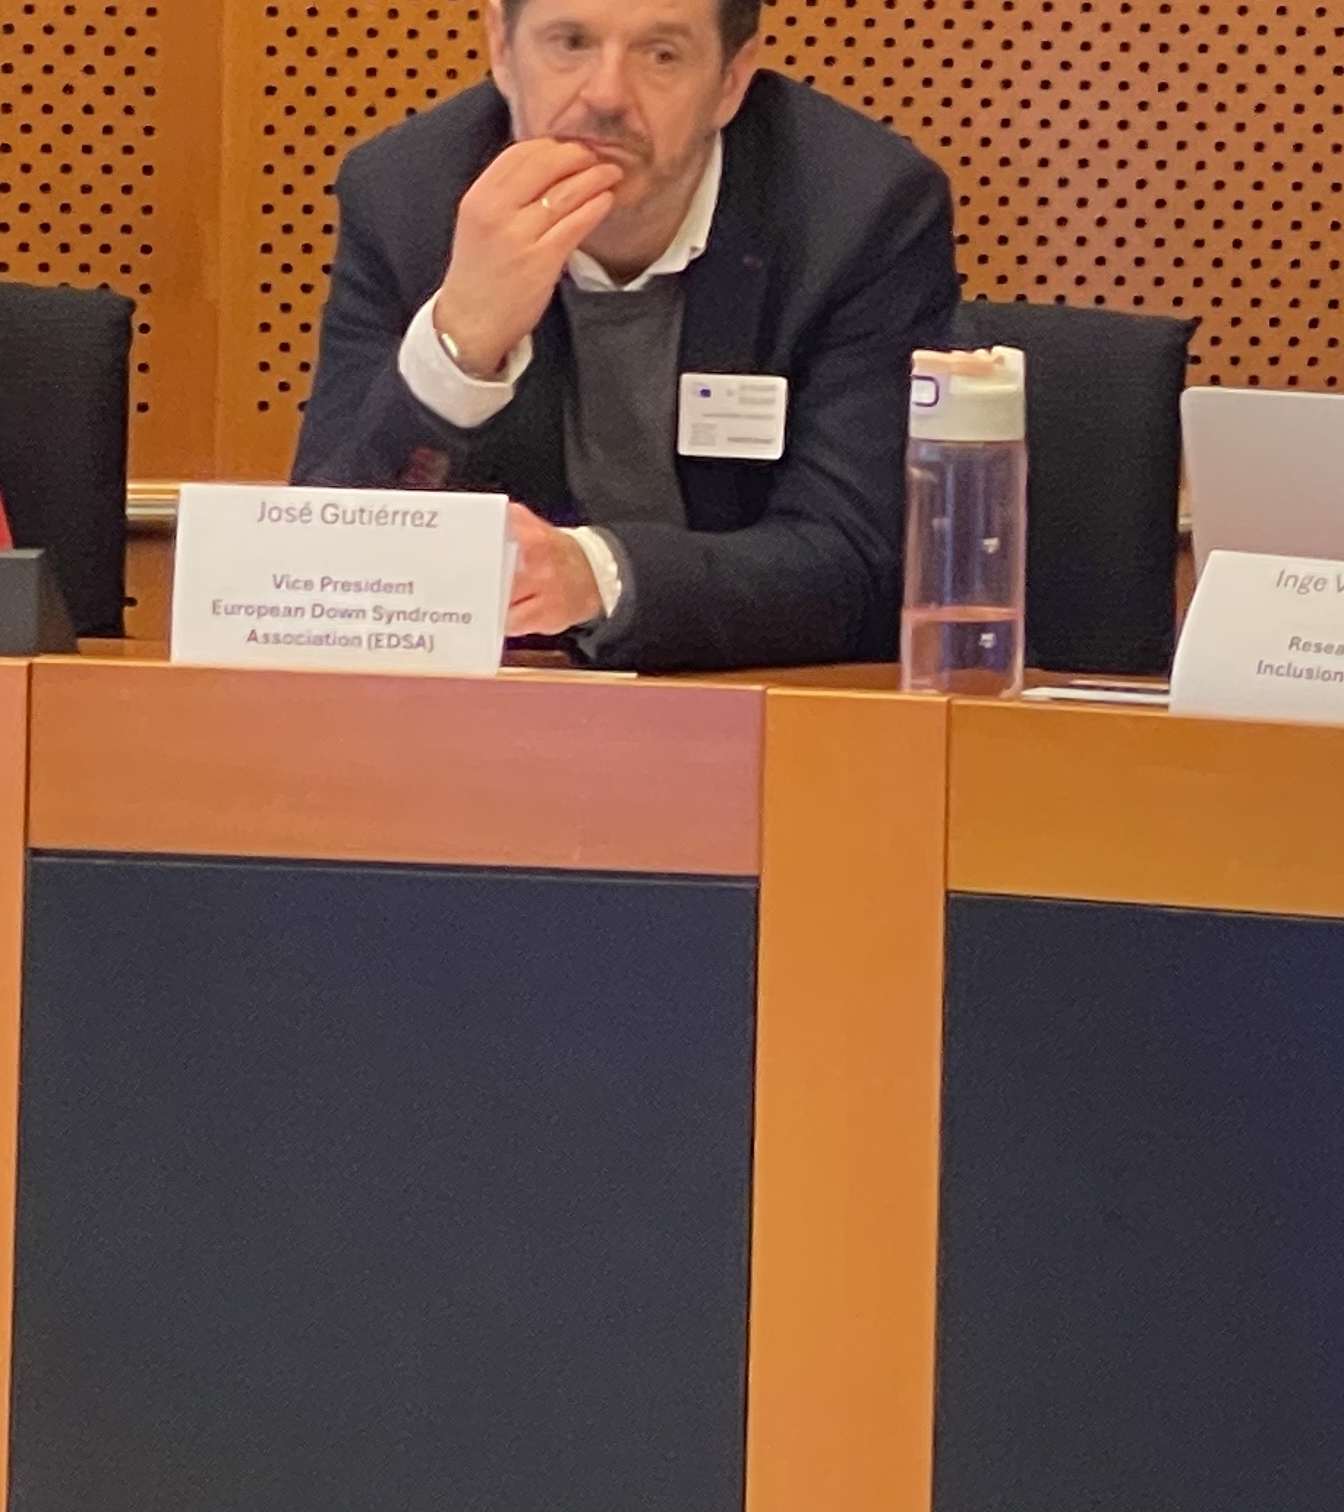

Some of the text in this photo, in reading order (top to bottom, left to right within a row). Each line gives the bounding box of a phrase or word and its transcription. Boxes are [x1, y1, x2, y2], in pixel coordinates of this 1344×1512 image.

[257, 501, 439, 529] José Gutiérrez
[272, 574, 415, 595] Vice President
[1276, 569, 1328, 595] Inge
[211, 599, 473, 626] European Down Syndrome
[246, 630, 435, 653] Association (EDSA)
[1256, 659, 1344, 684] Inclusion
